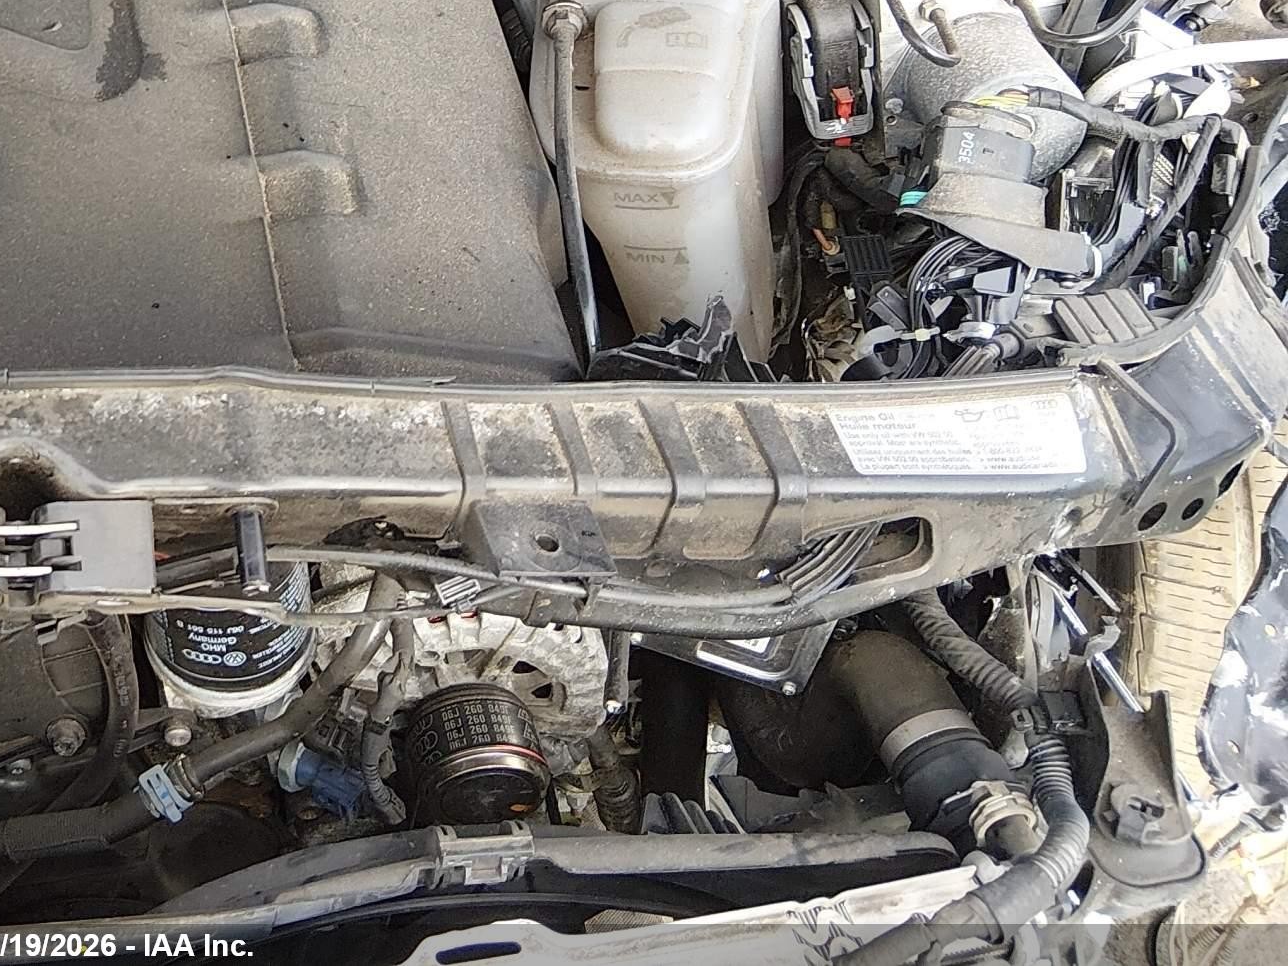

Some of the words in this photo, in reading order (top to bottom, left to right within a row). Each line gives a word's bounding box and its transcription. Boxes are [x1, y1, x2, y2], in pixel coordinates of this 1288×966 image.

[614, 192, 659, 203] MAX
[626, 252, 666, 264] MIN
[878, 412, 895, 421] Oil
[188, 631, 237, 644] Germany
[441, 708, 460, 721] 06J
[464, 704, 483, 714] 260
[444, 718, 463, 731] 06J
[467, 714, 486, 725] 260
[446, 727, 465, 741] 06J
[470, 724, 488, 734] 260
